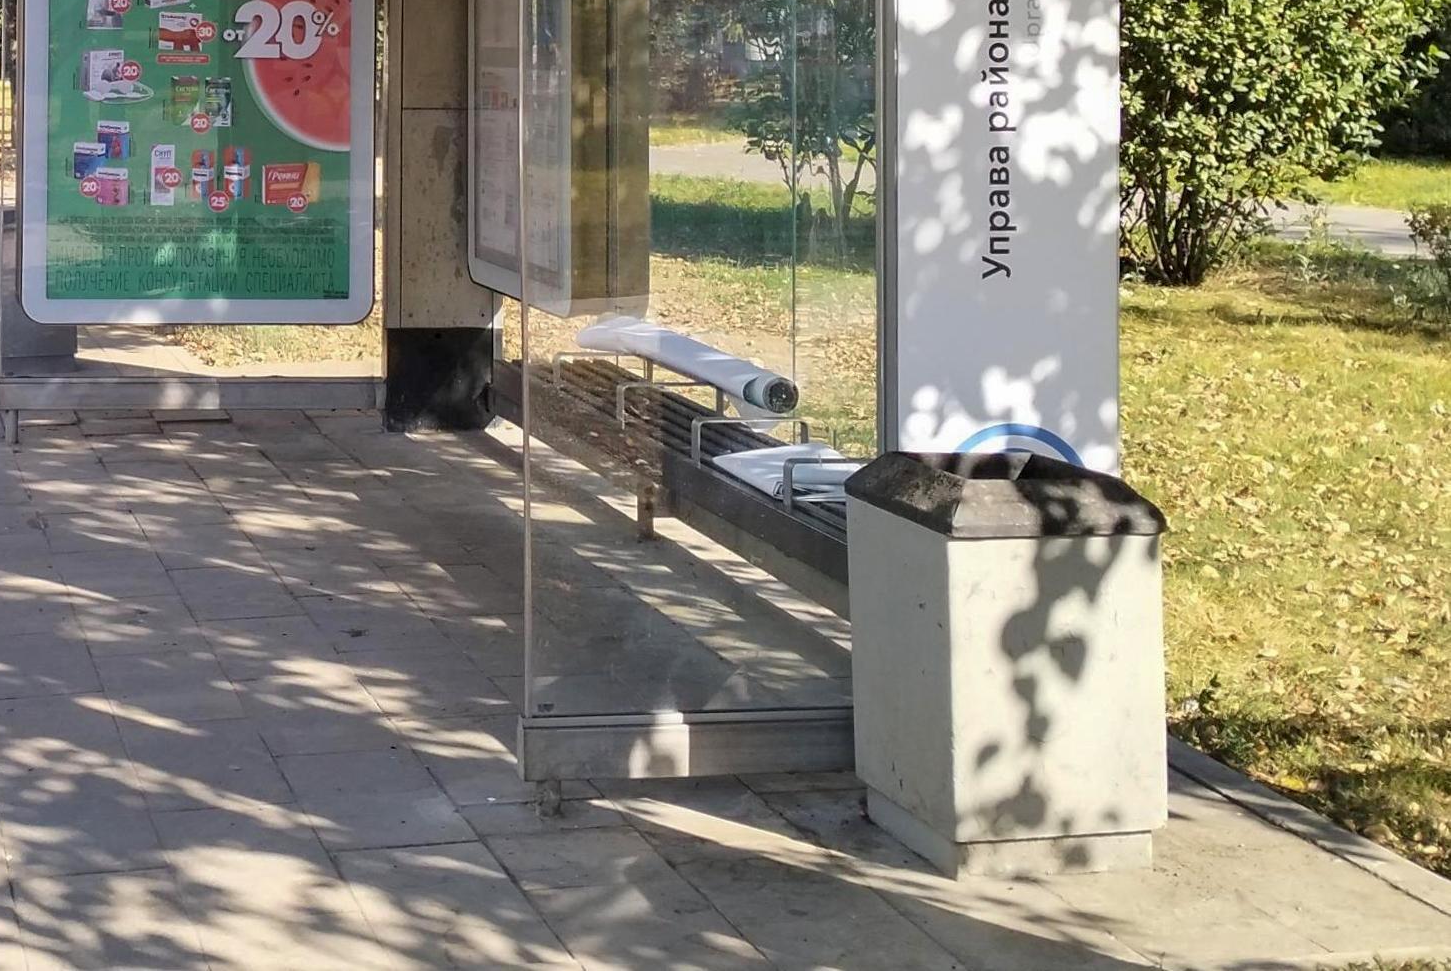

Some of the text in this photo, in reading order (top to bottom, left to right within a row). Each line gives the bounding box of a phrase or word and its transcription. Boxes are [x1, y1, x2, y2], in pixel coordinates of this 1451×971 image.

[222, 28, 246, 42] от
[981, 146, 1017, 279] Управа
[55, 269, 130, 291] ПОЛУЧЕНИЕ
[138, 271, 237, 293] КОНСУЛЬТАЦИИ
[245, 271, 335, 294] СПЕЦИАЛИСТА
